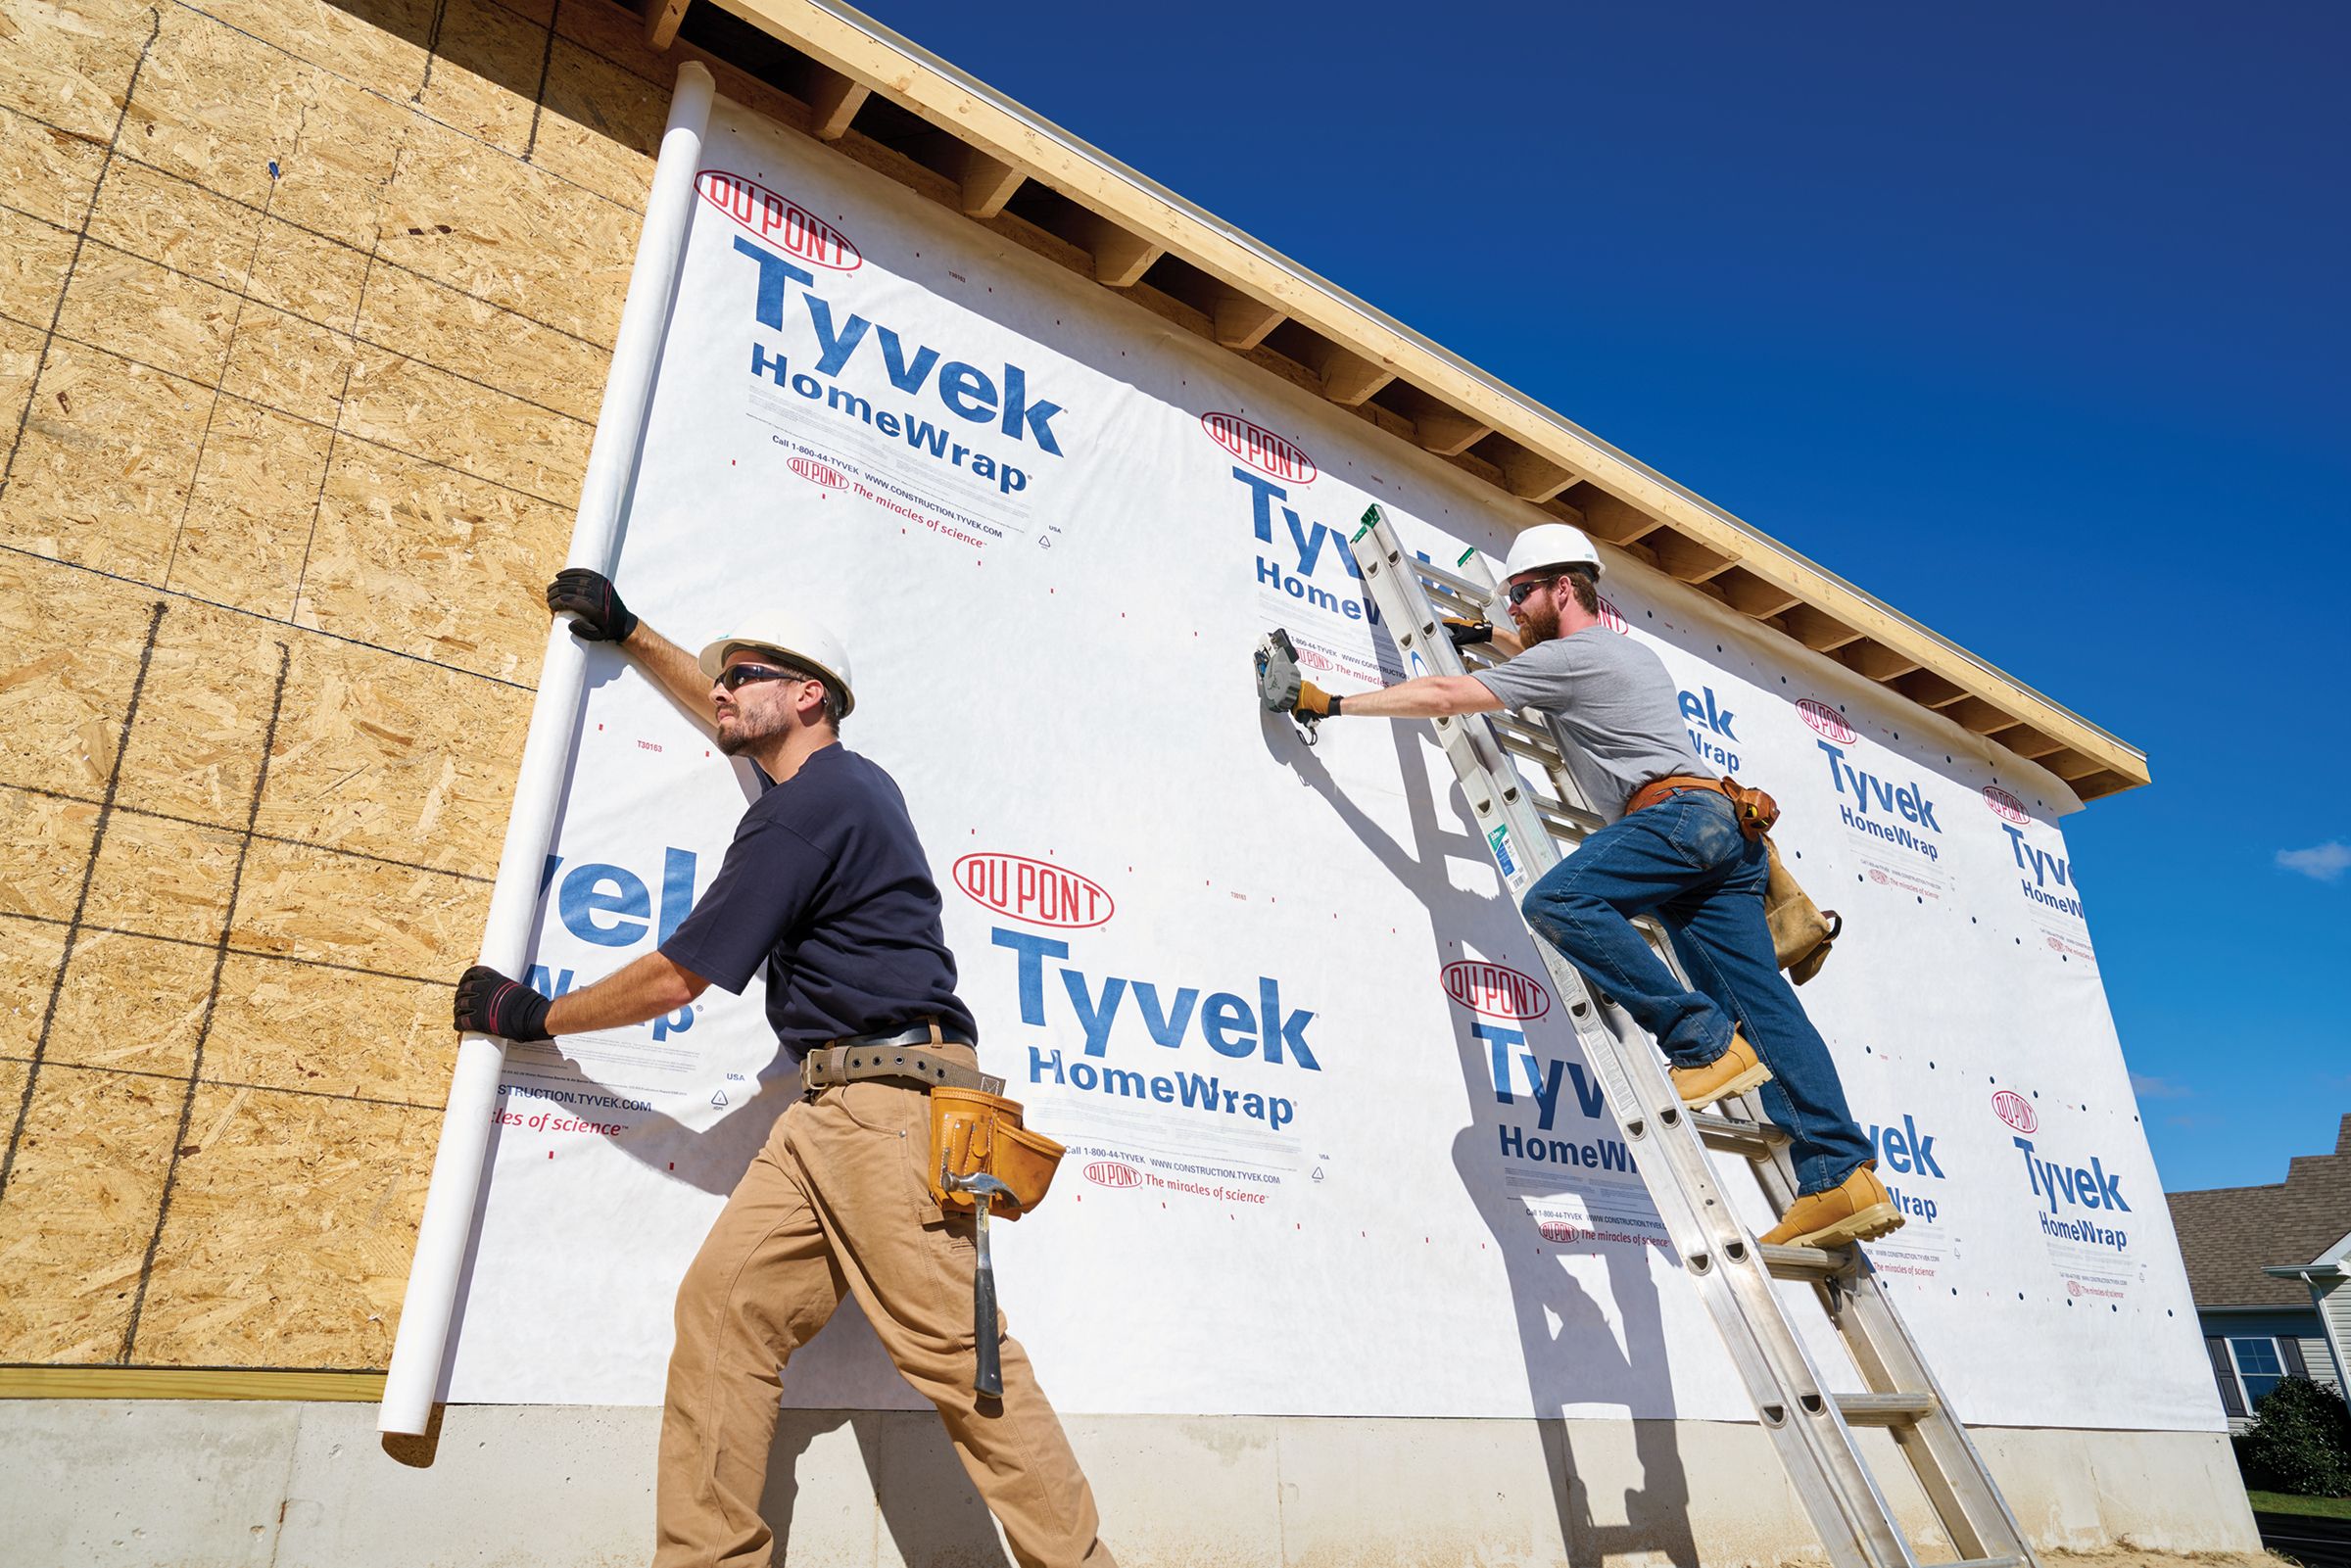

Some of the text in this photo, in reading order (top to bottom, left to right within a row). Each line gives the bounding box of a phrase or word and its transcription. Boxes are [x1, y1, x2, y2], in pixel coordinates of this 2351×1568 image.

[733, 235, 1064, 457] Tyvek
[750, 342, 1028, 495] HomeWrap
[772, 435, 1003, 539] Call 1-800-44-TYVEK WWW.CONSTRUCTION.TYVEK.COM
[853, 482, 983, 548] The miracles of science
[1048, 524, 1062, 534] USA
[1335, 663, 1389, 688] The miracles
[637, 739, 662, 753] T30163
[1816, 738, 1943, 833] Tyvek
[1840, 803, 1939, 862] HomeWrap
[991, 927, 1321, 1071] Tyvek
[726, 1072, 746, 1082] USA
[1028, 1046, 1293, 1131] HomeWrap
[492, 1108, 621, 1136] les of science
[1065, 1145, 1281, 1184] Call 1-800-44-TYVEK WWW.CONSTRUCTION.TYVEK.COM
[2013, 1136, 2132, 1213] Tyvek
[1145, 1173, 1266, 1204] The miracles of science
[1539, 1210, 1583, 1221] 1-800-44-TYVEK
[2039, 1211, 2127, 1252] HomeWrap
[1581, 1229, 1596, 1241] The
[1598, 1230, 1631, 1244] miracles
[1633, 1233, 1642, 1246] of
